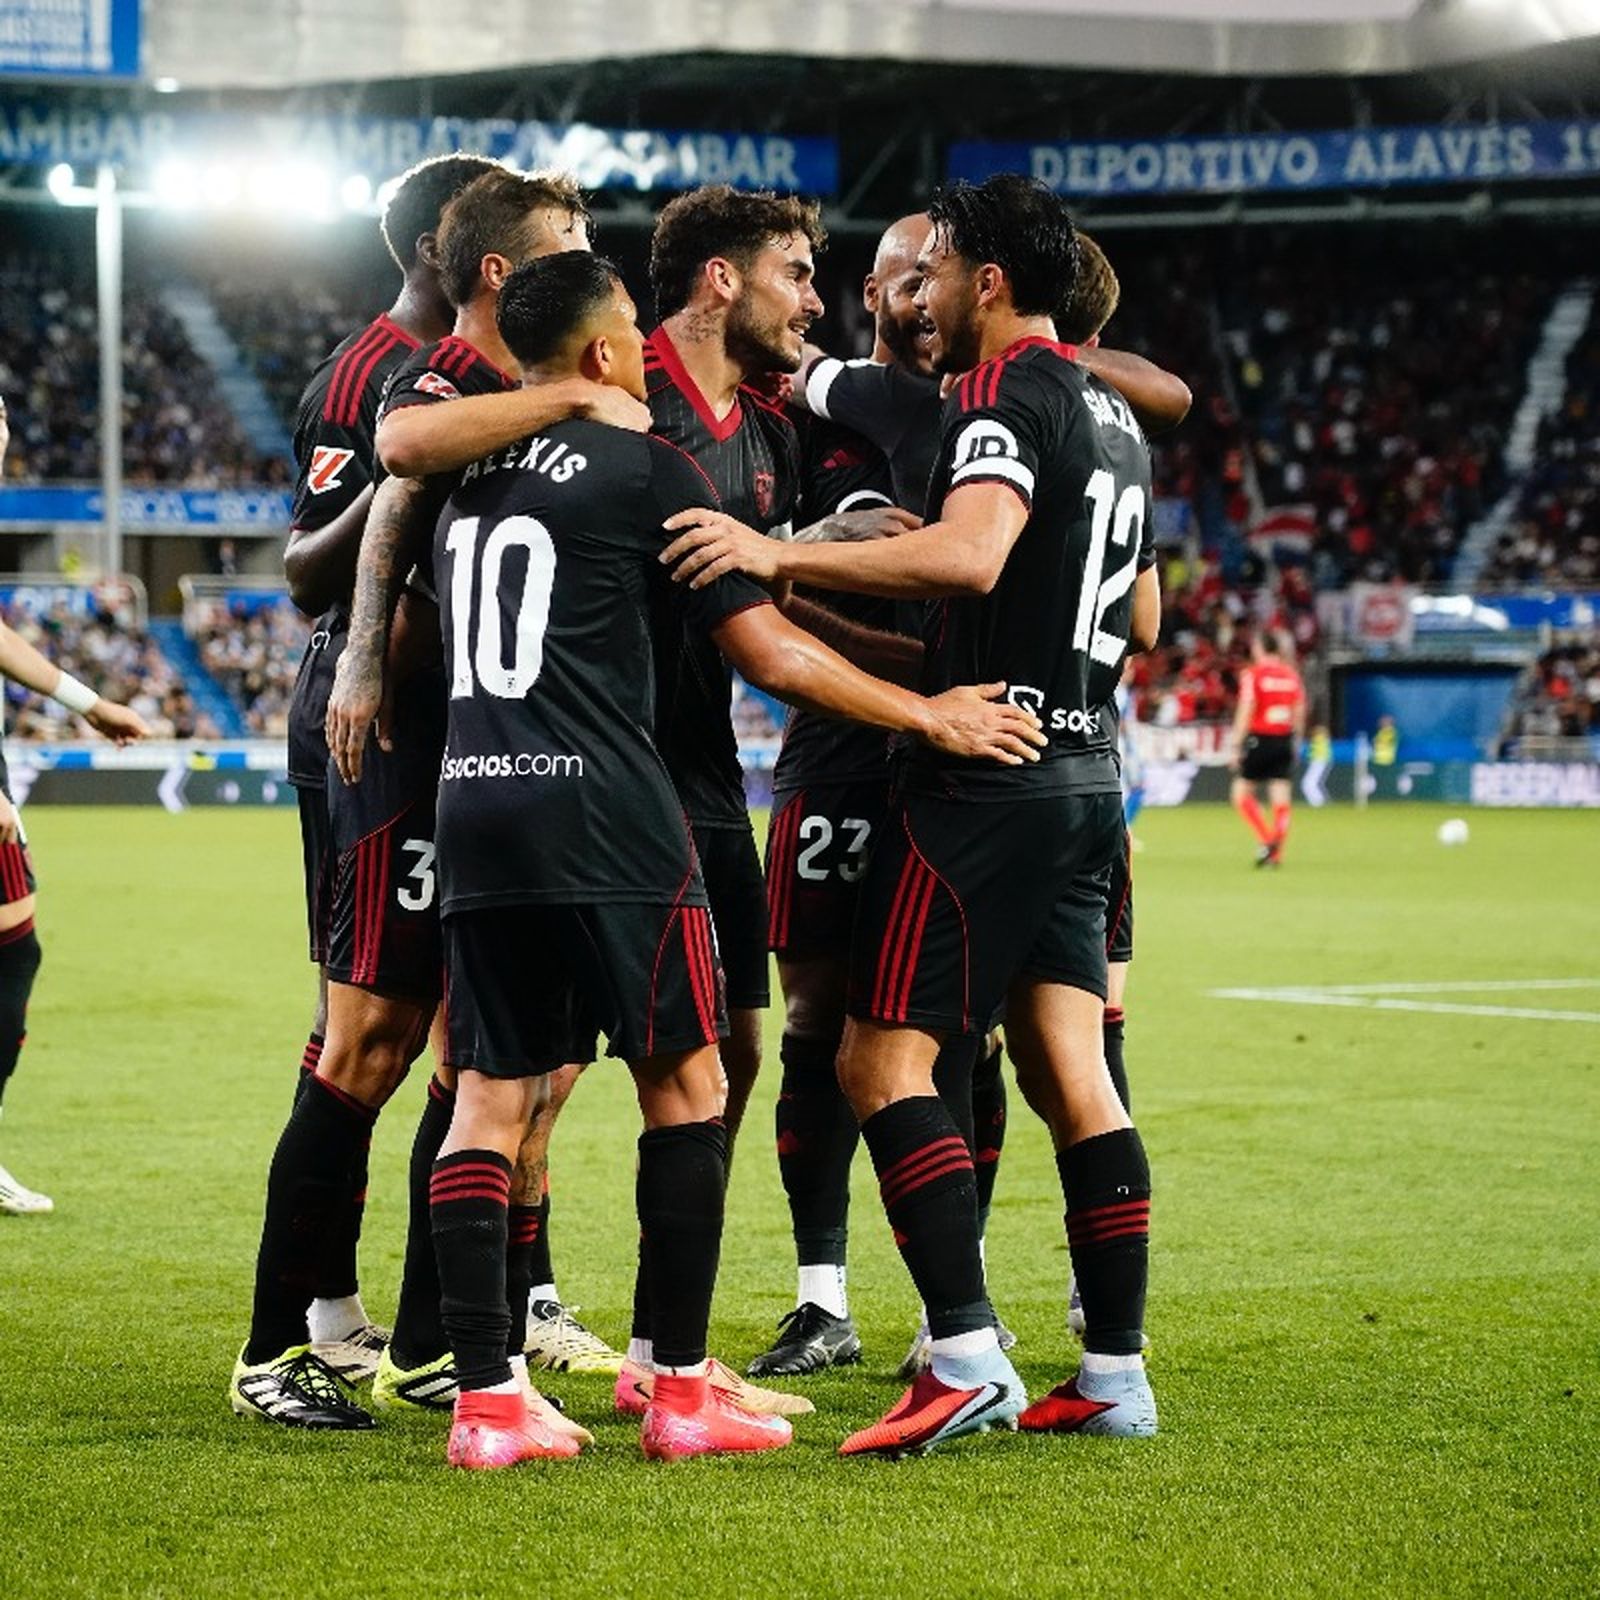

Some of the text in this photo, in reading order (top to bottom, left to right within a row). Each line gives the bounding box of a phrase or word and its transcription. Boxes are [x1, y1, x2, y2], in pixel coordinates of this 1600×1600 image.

[1030, 139, 1319, 192] DEPORTIVO
[1344, 119, 1534, 179] ALAVÉS
[446, 514, 557, 700] 10
[1073, 468, 1146, 668] 12
[796, 814, 872, 882] 23
